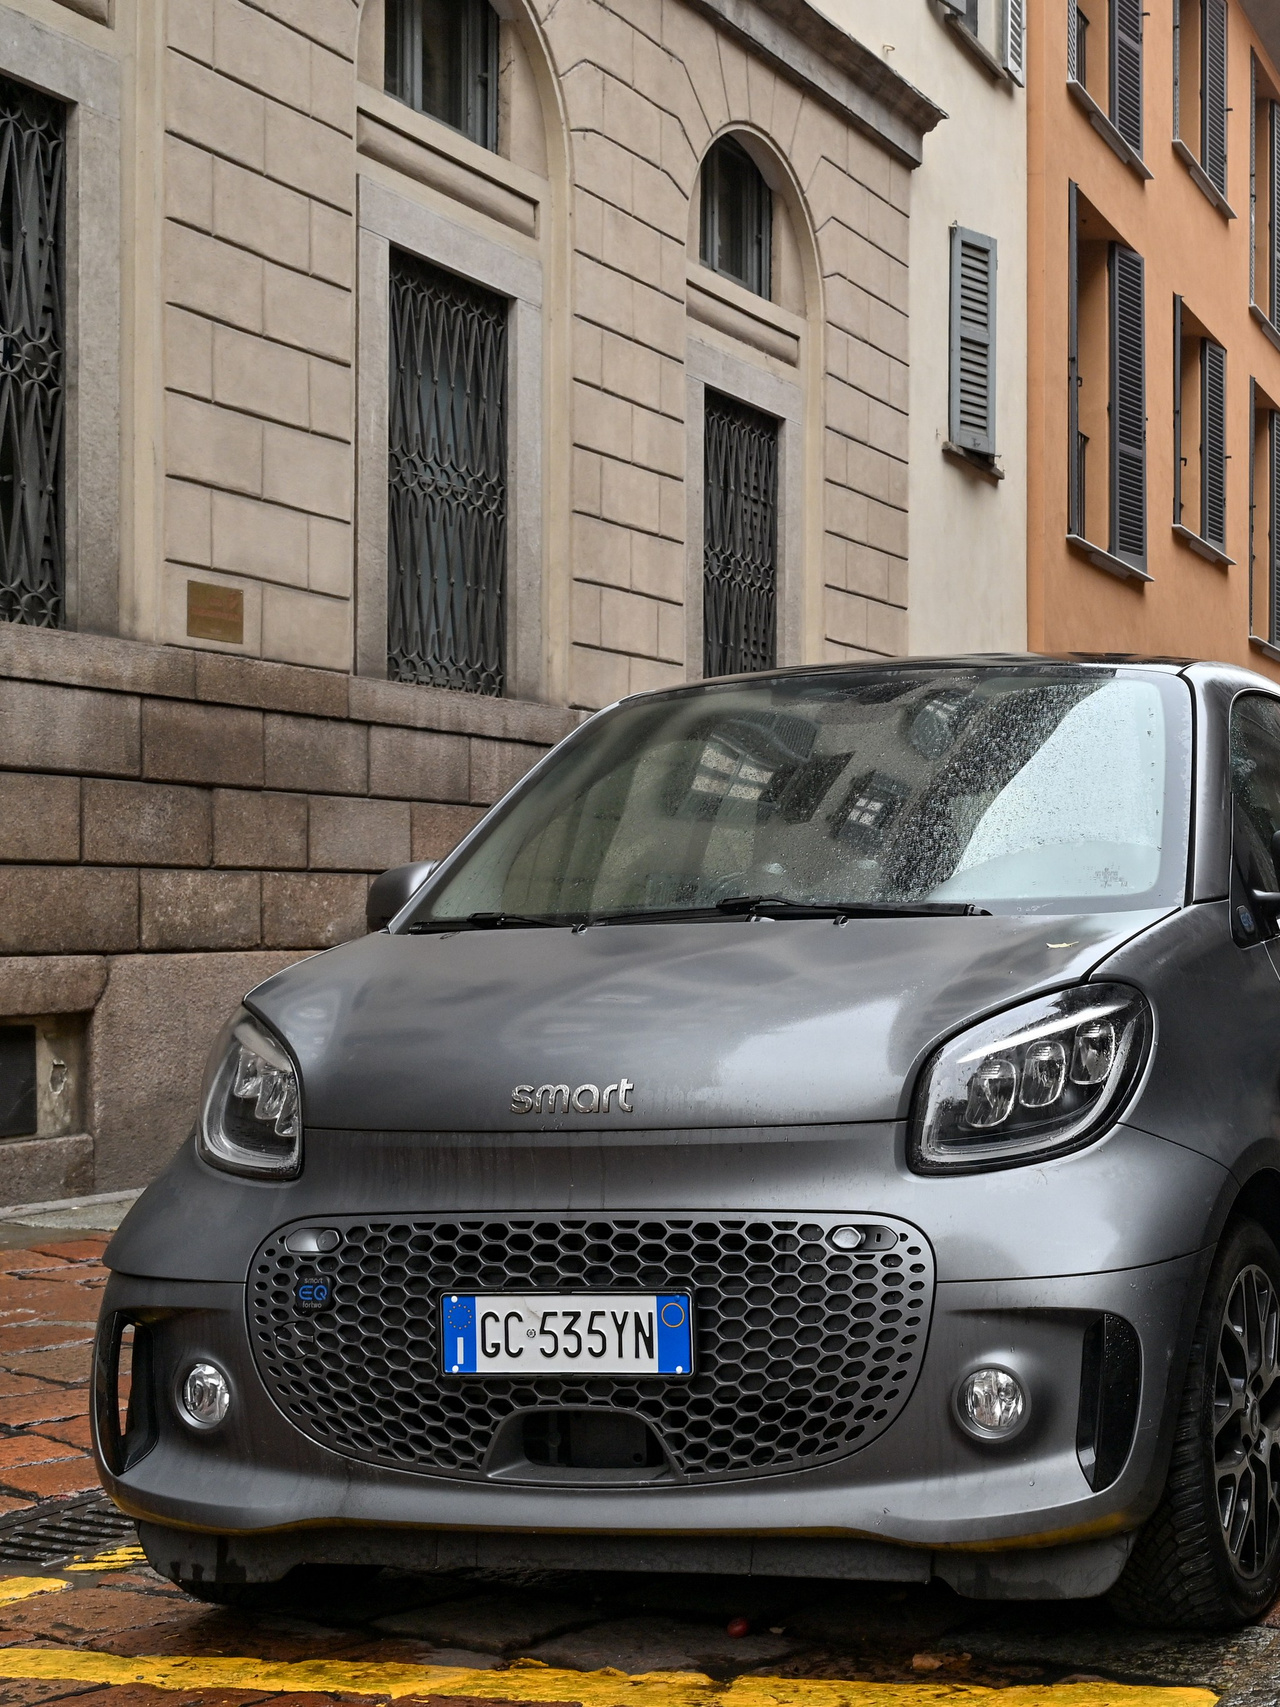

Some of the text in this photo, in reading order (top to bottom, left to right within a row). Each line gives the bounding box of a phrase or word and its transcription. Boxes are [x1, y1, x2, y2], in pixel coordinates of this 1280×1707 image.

[510, 1078, 634, 1114] smart
[299, 1285, 327, 1301] EQ
[480, 1310, 655, 1360] GC 535YN
